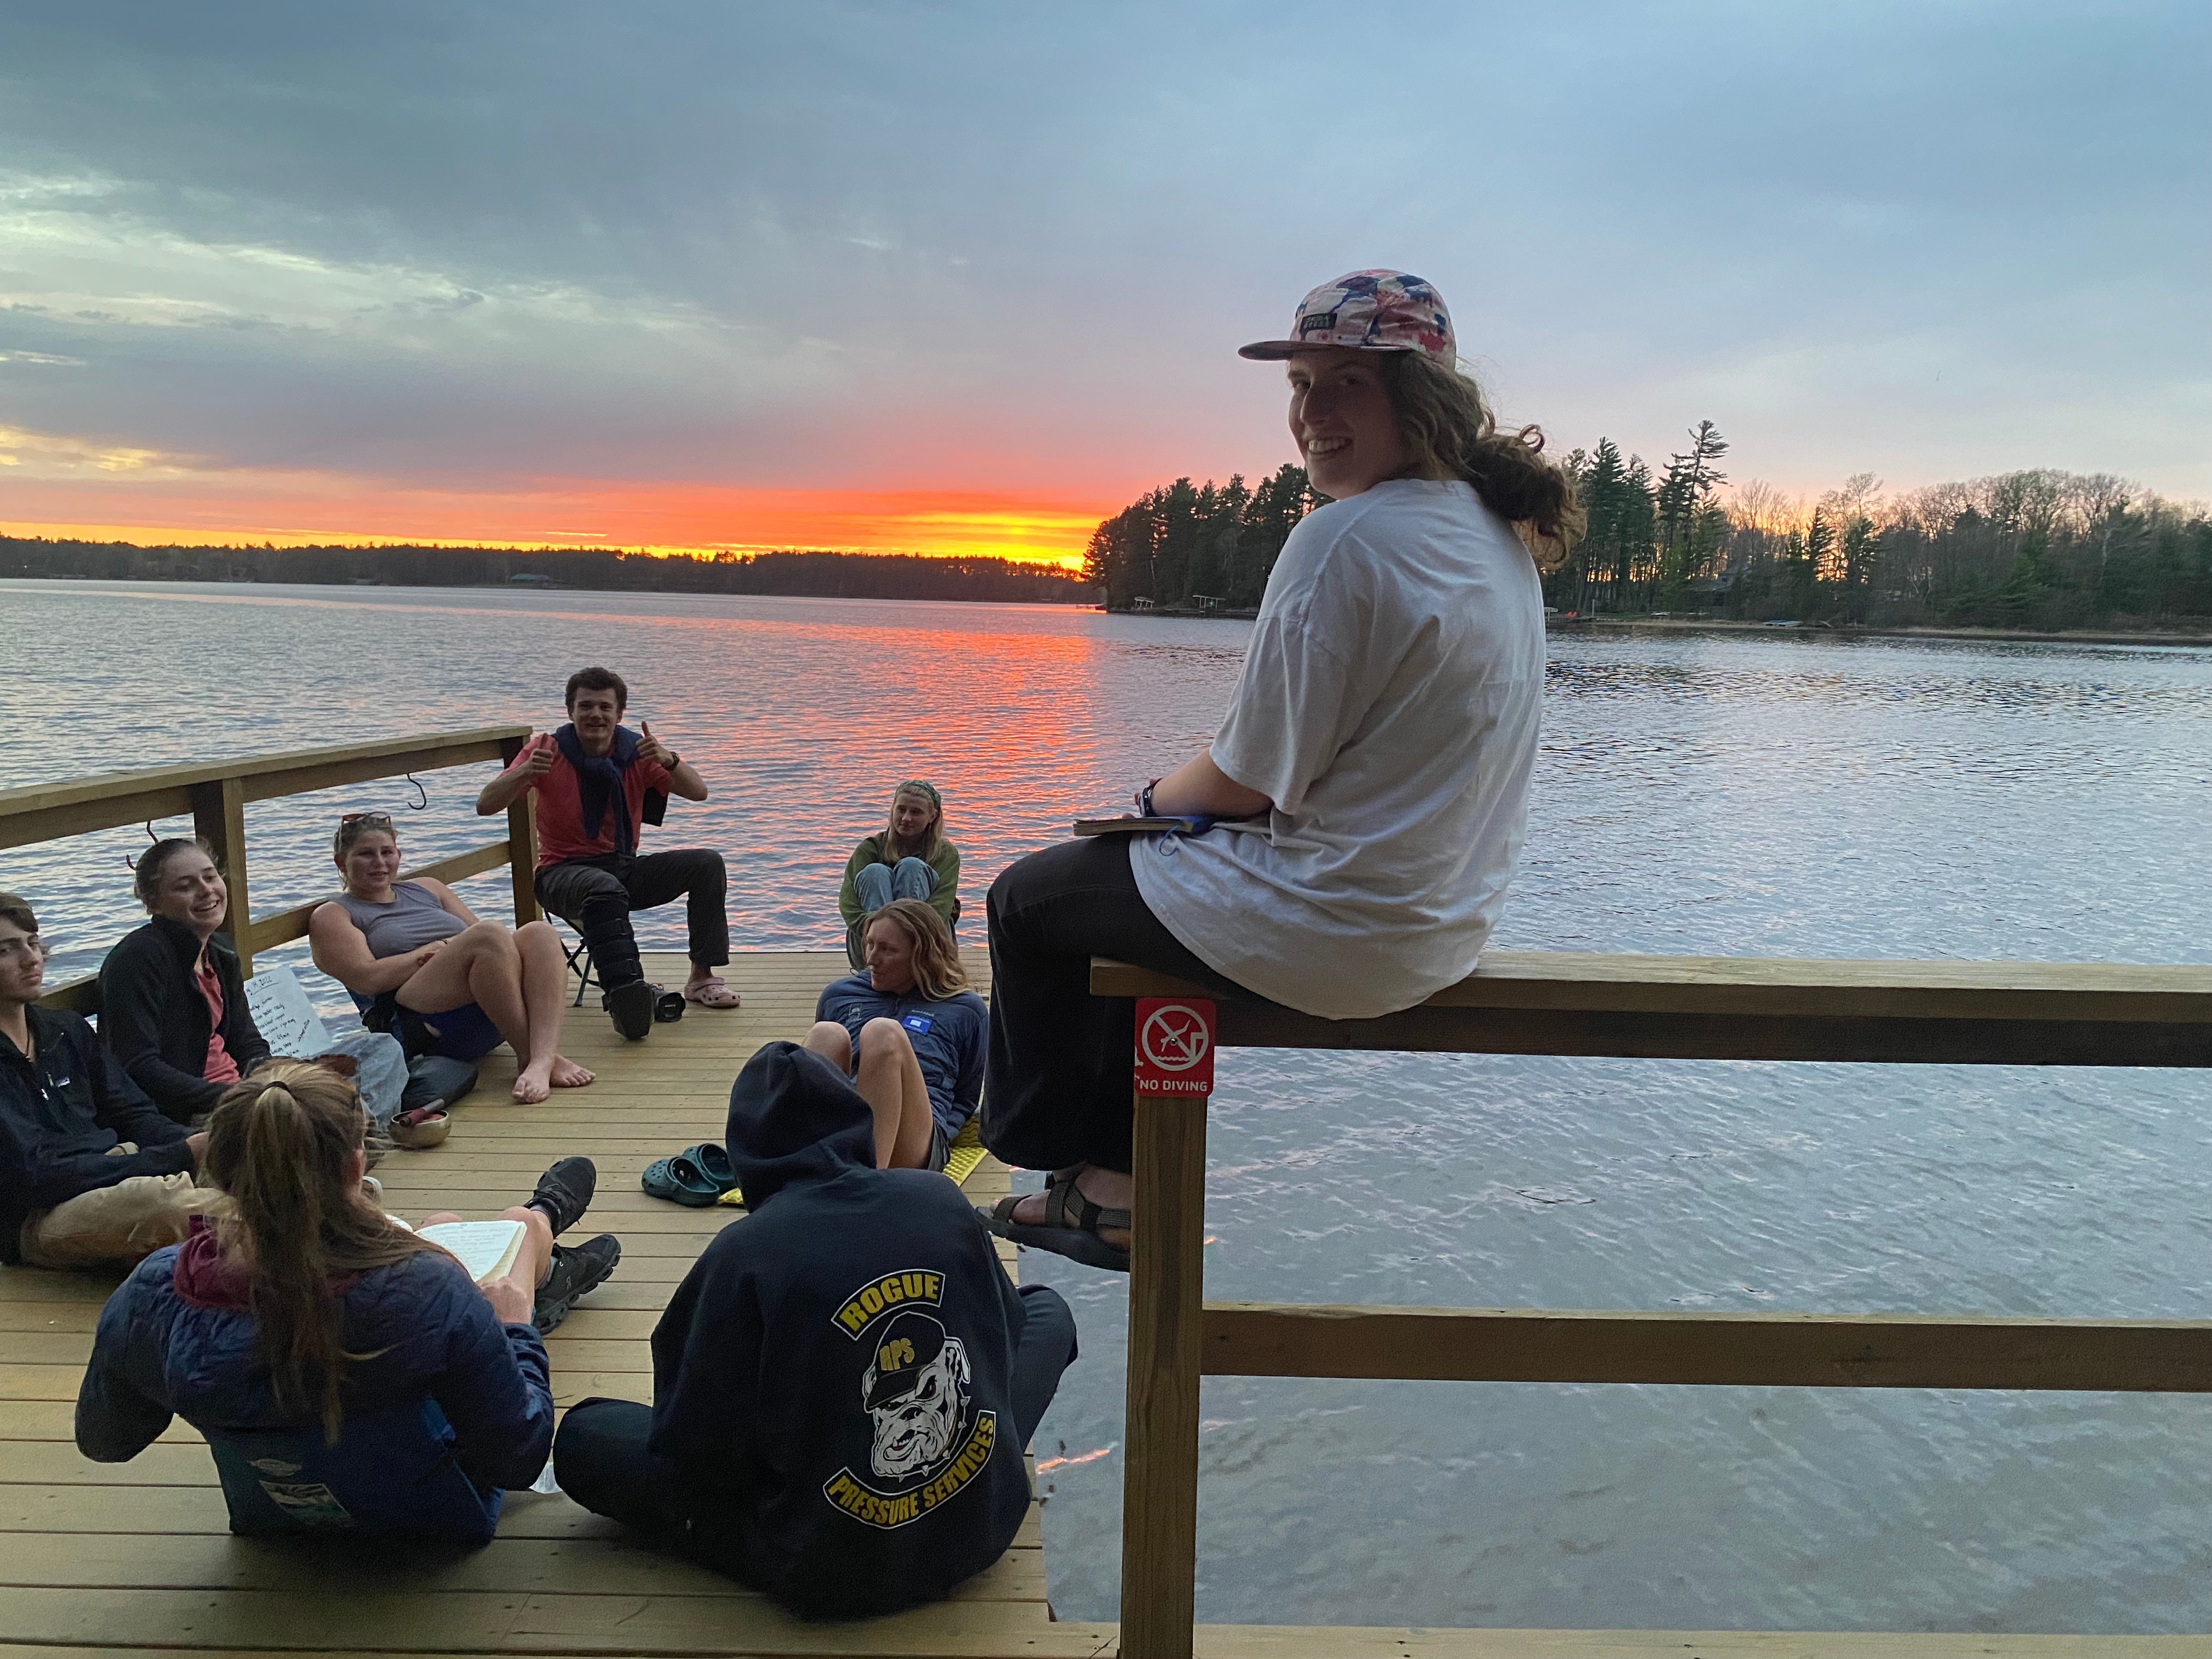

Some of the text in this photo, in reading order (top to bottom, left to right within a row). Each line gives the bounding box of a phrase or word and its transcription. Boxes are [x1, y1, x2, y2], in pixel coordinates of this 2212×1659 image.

[1139, 1080, 1207, 1092] NO DIVING
[839, 1274, 939, 1331] ROGUE
[879, 1338, 915, 1370] RPS
[828, 1417, 994, 1525] PRESSURE SERVICES
